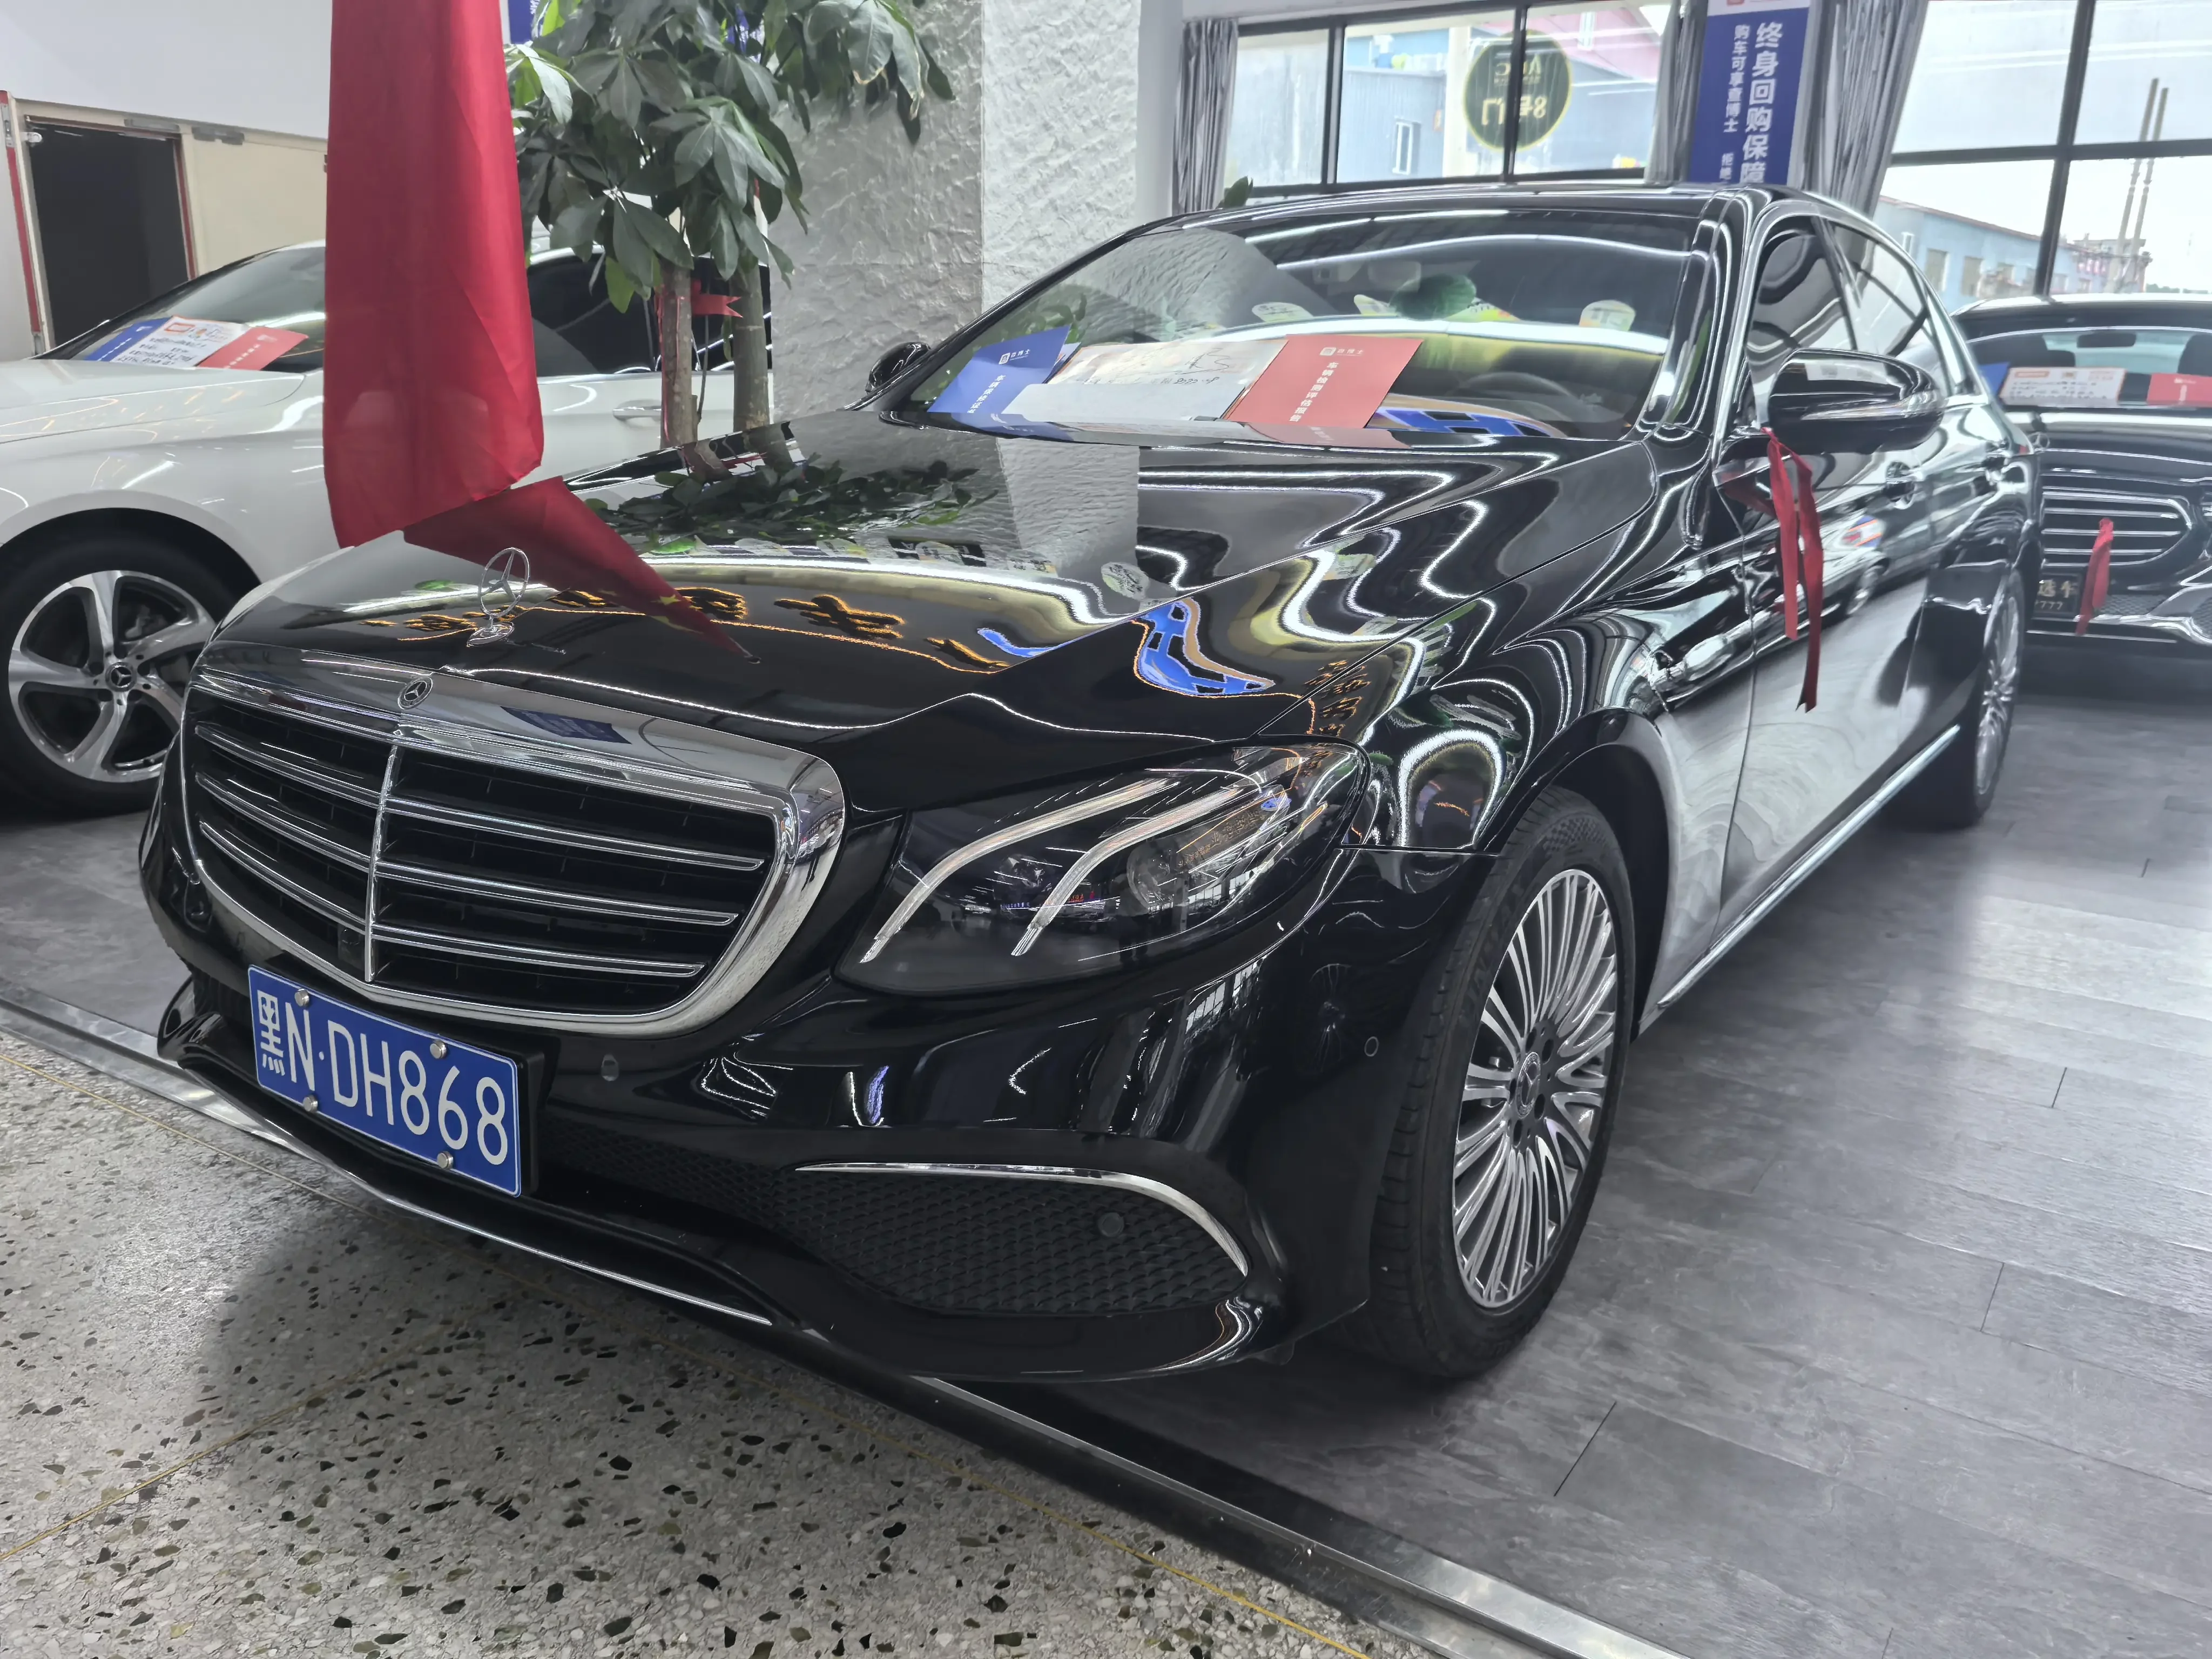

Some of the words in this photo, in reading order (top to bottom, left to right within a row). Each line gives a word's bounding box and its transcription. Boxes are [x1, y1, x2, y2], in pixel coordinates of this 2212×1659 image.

[1739, 22, 1783, 183] 终身回购保障
[257, 989, 508, 1166] 黑N·DH868
